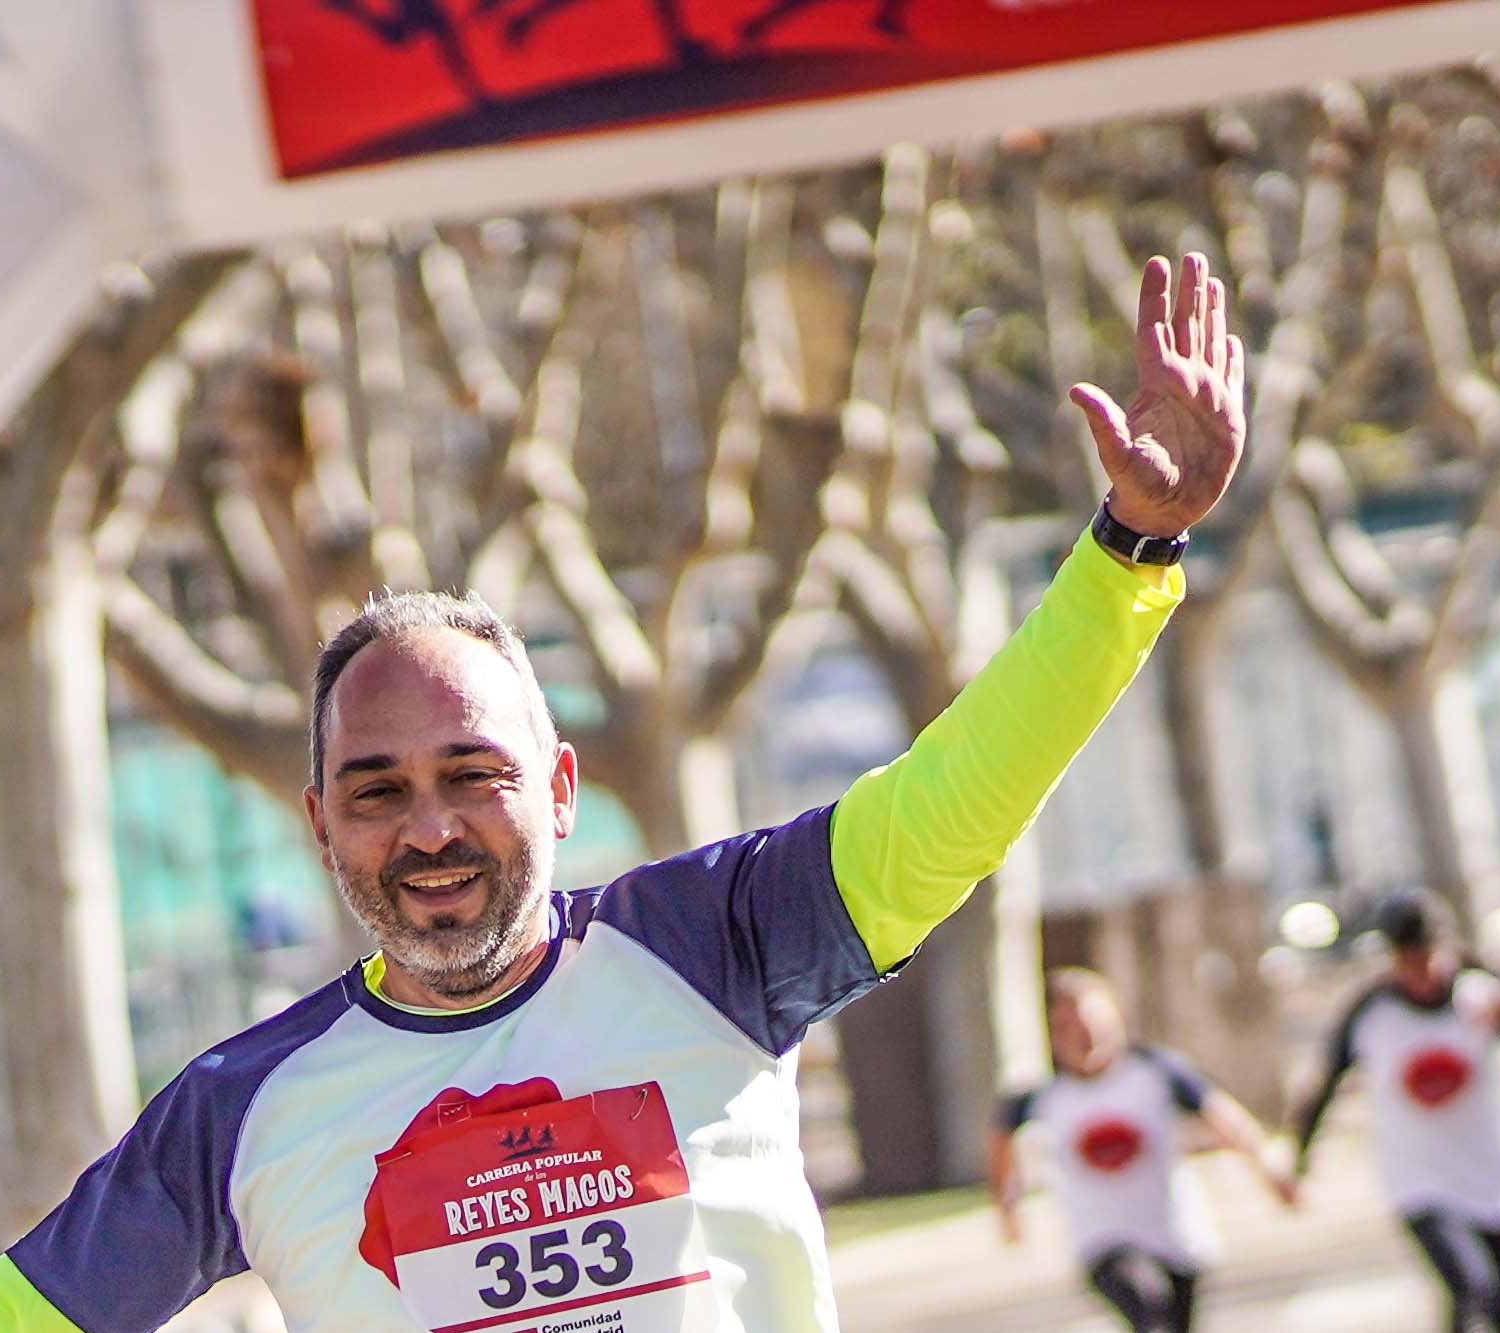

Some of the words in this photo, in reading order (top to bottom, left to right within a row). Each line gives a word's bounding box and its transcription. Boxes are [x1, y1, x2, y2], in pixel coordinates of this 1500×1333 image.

[443, 1186, 531, 1236] REYES
[537, 1164, 635, 1218] MAGOS
[466, 1161, 533, 1188] CARRERA
[534, 1149, 603, 1170] POPULAR
[474, 1219, 634, 1311] 353
